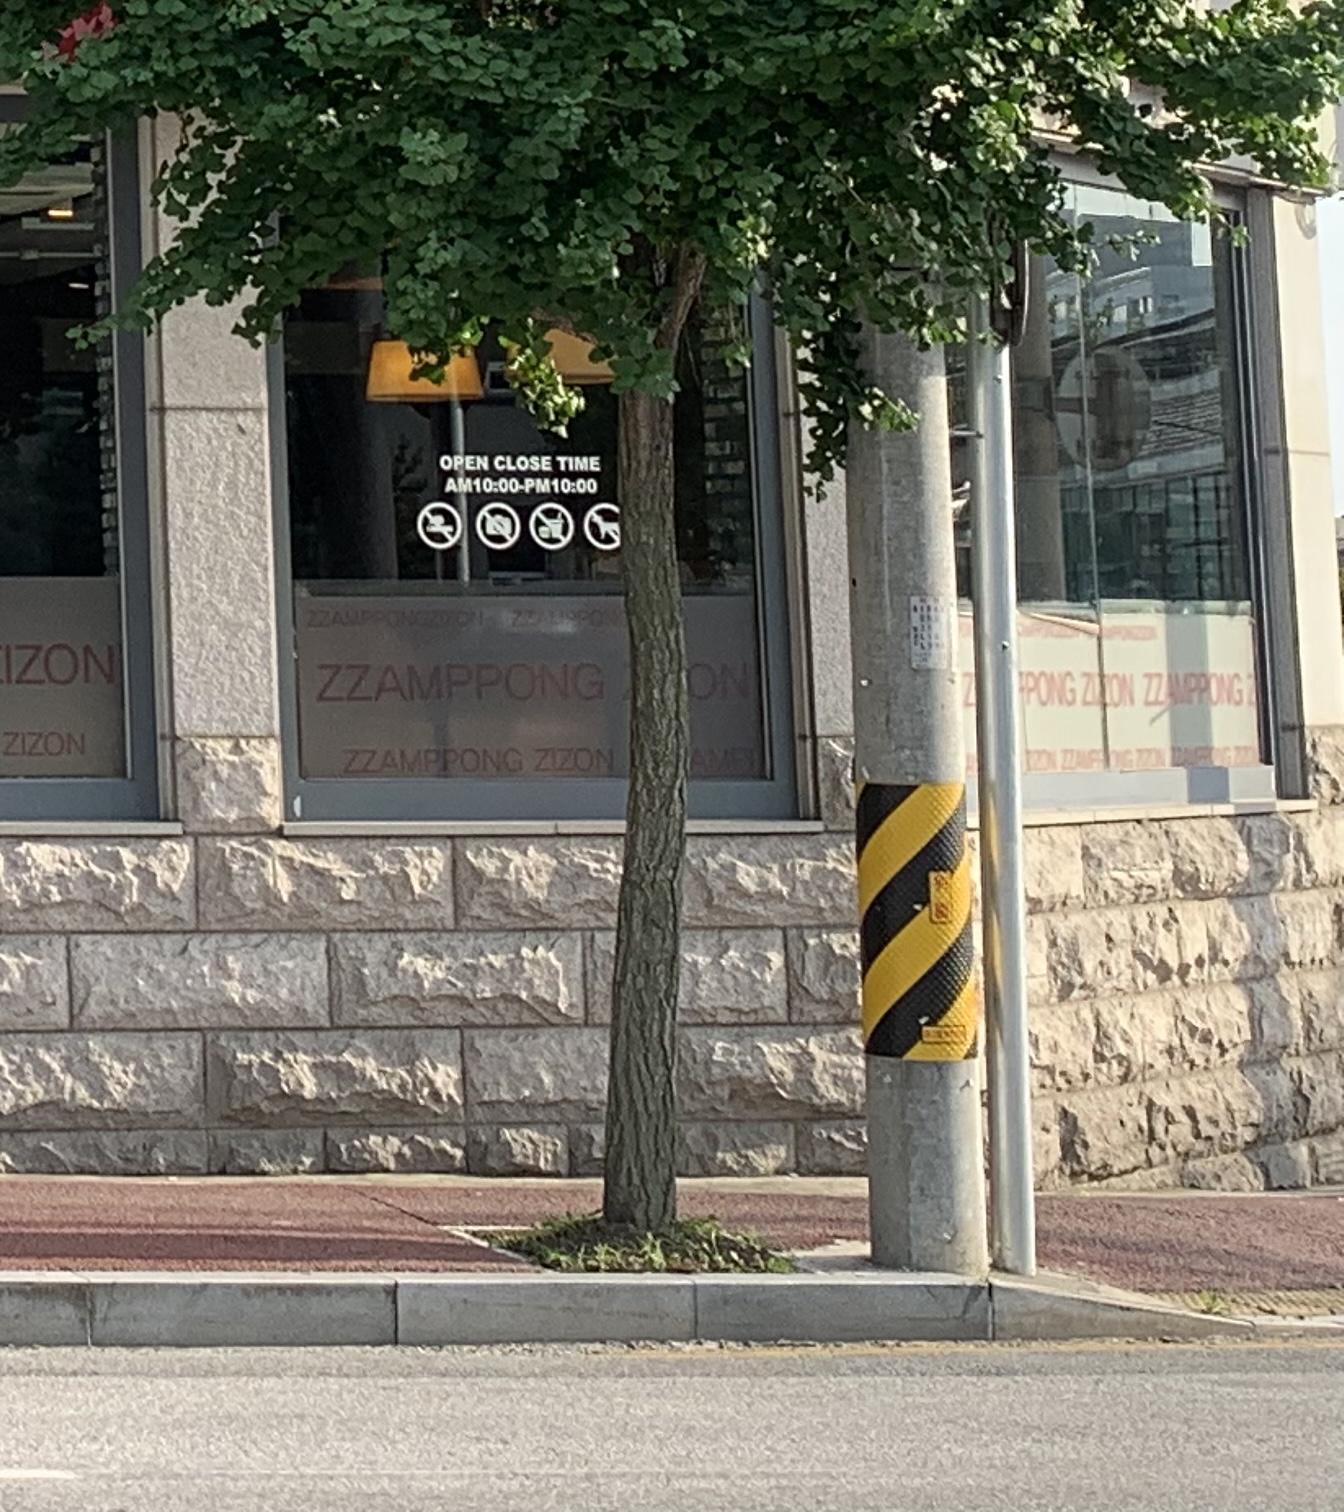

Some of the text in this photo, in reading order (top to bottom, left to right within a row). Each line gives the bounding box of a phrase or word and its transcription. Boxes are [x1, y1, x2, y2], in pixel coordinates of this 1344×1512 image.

[440, 455, 601, 473] OPEN CLOSE TIME
[444, 478, 598, 494] AM10:00-PM10:00
[315, 662, 606, 703] ZZAMPPONG
[3, 731, 87, 757] ZIZON
[342, 747, 524, 775] ZZAMPPONG
